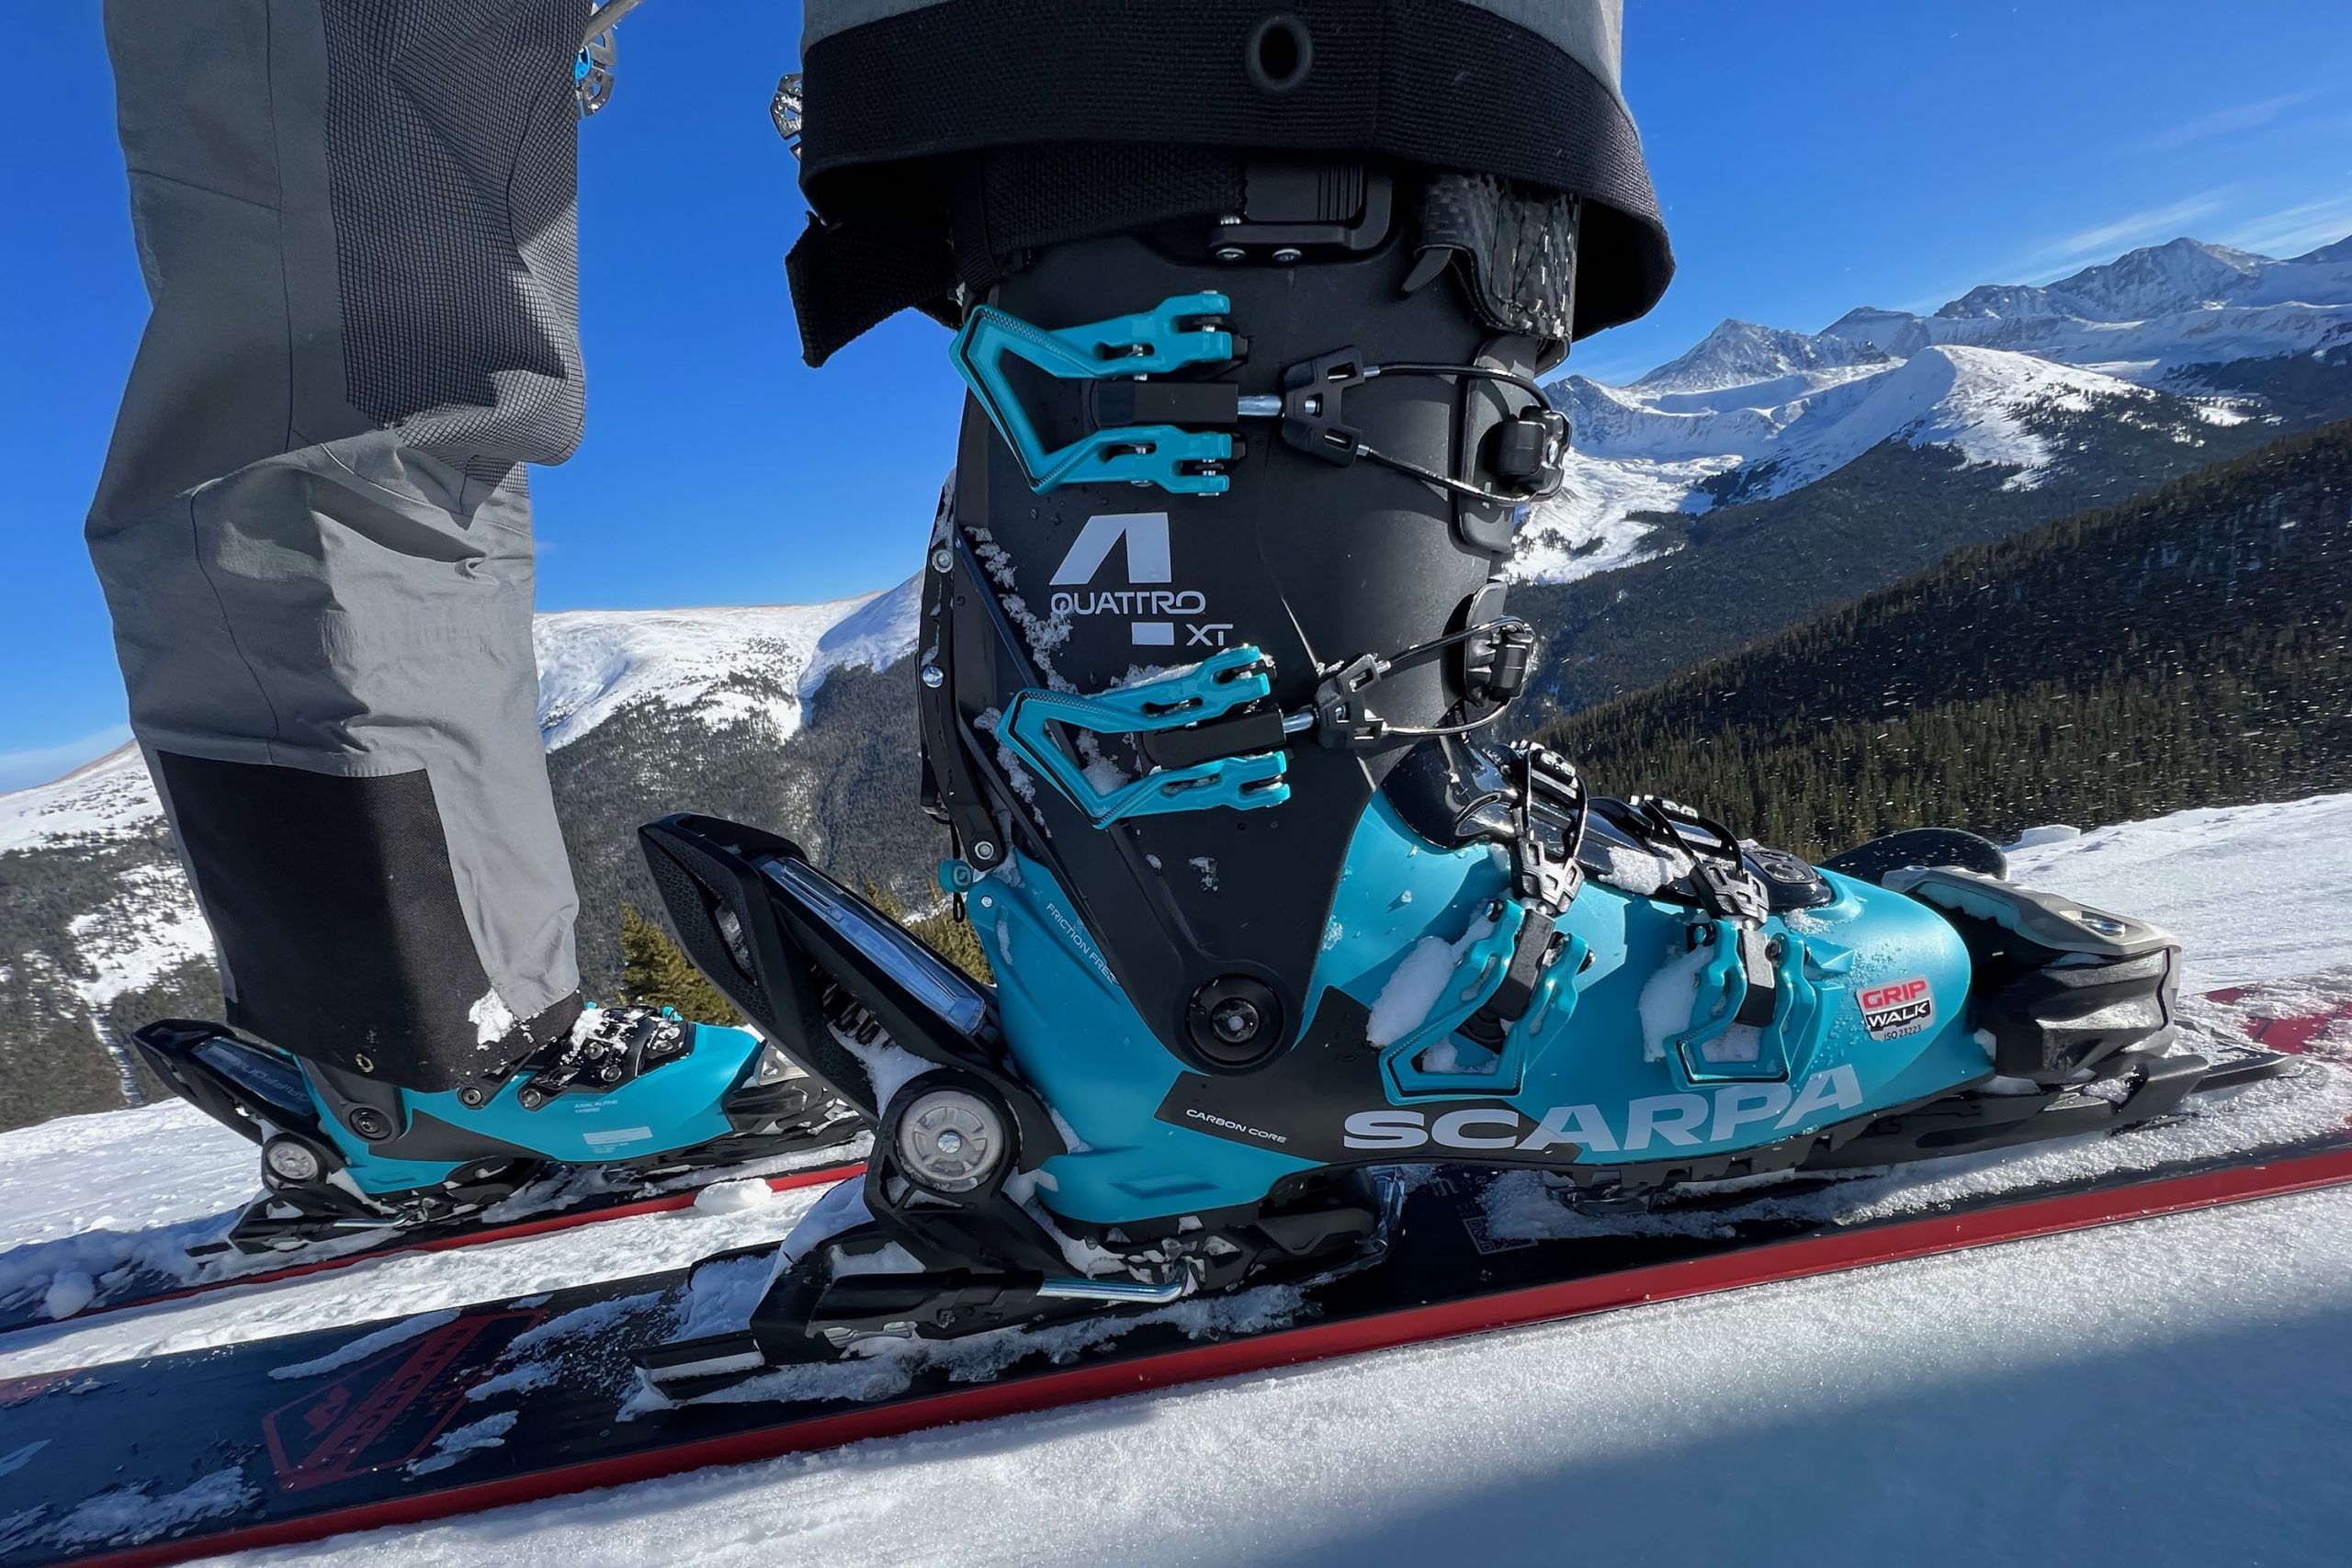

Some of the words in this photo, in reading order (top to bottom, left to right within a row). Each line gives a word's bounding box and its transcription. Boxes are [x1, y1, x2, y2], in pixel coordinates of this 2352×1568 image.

[1050, 591, 1206, 615] QUATTRO
[1186, 624, 1234, 647] XT
[1046, 903, 1091, 954] FRICTION
[1862, 979, 1927, 1009] GRIP
[1868, 1002, 1928, 1027] WALK
[1883, 1031, 1898, 1041] ISO
[1899, 1024, 1921, 1038] 23223
[1342, 1064, 1863, 1151] SCARPA
[1186, 1109, 1247, 1132] CARBON
[1248, 1128, 1287, 1144] CORE
